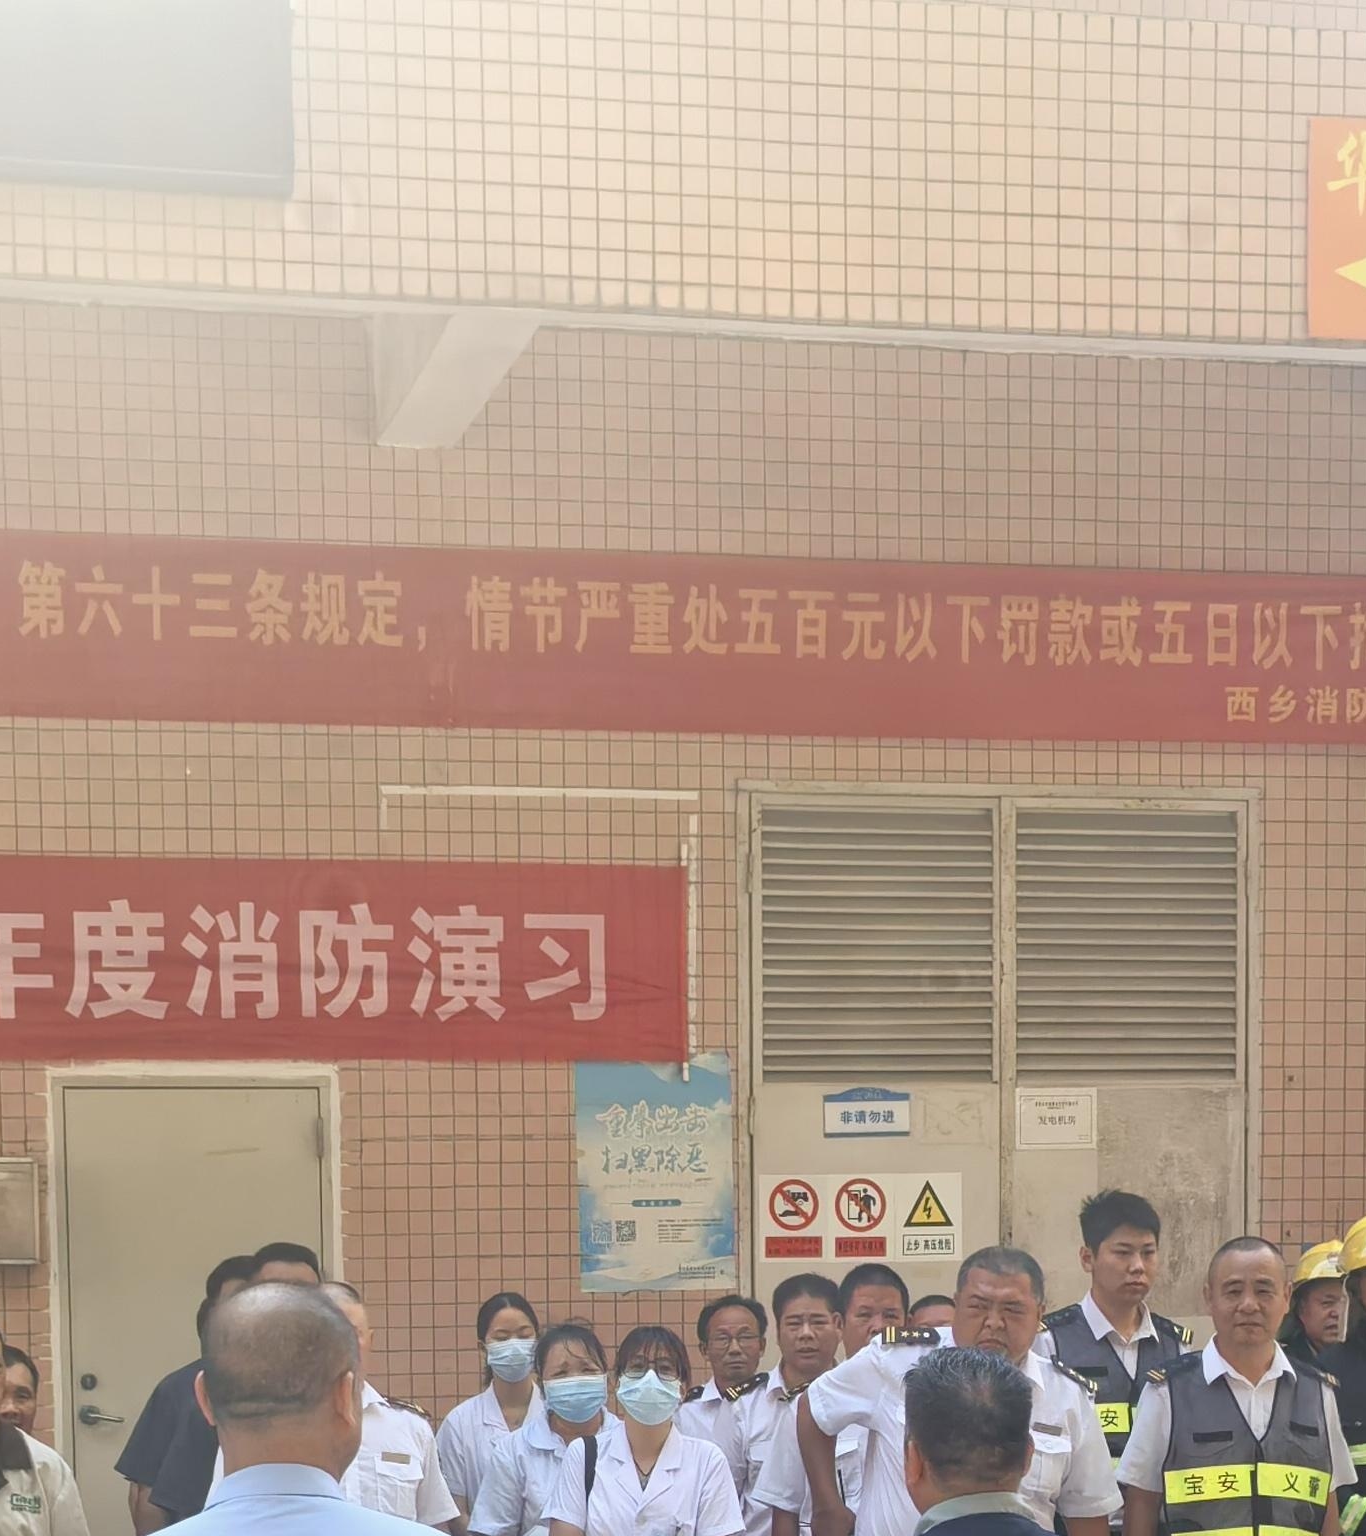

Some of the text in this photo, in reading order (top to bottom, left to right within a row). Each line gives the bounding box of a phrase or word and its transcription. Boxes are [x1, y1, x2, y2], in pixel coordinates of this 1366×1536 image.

[840, 1110, 895, 1124] 非请勿进
[602, 1144, 708, 1175] 扫黑除恶
[1184, 1471, 1239, 1496] 宝安
